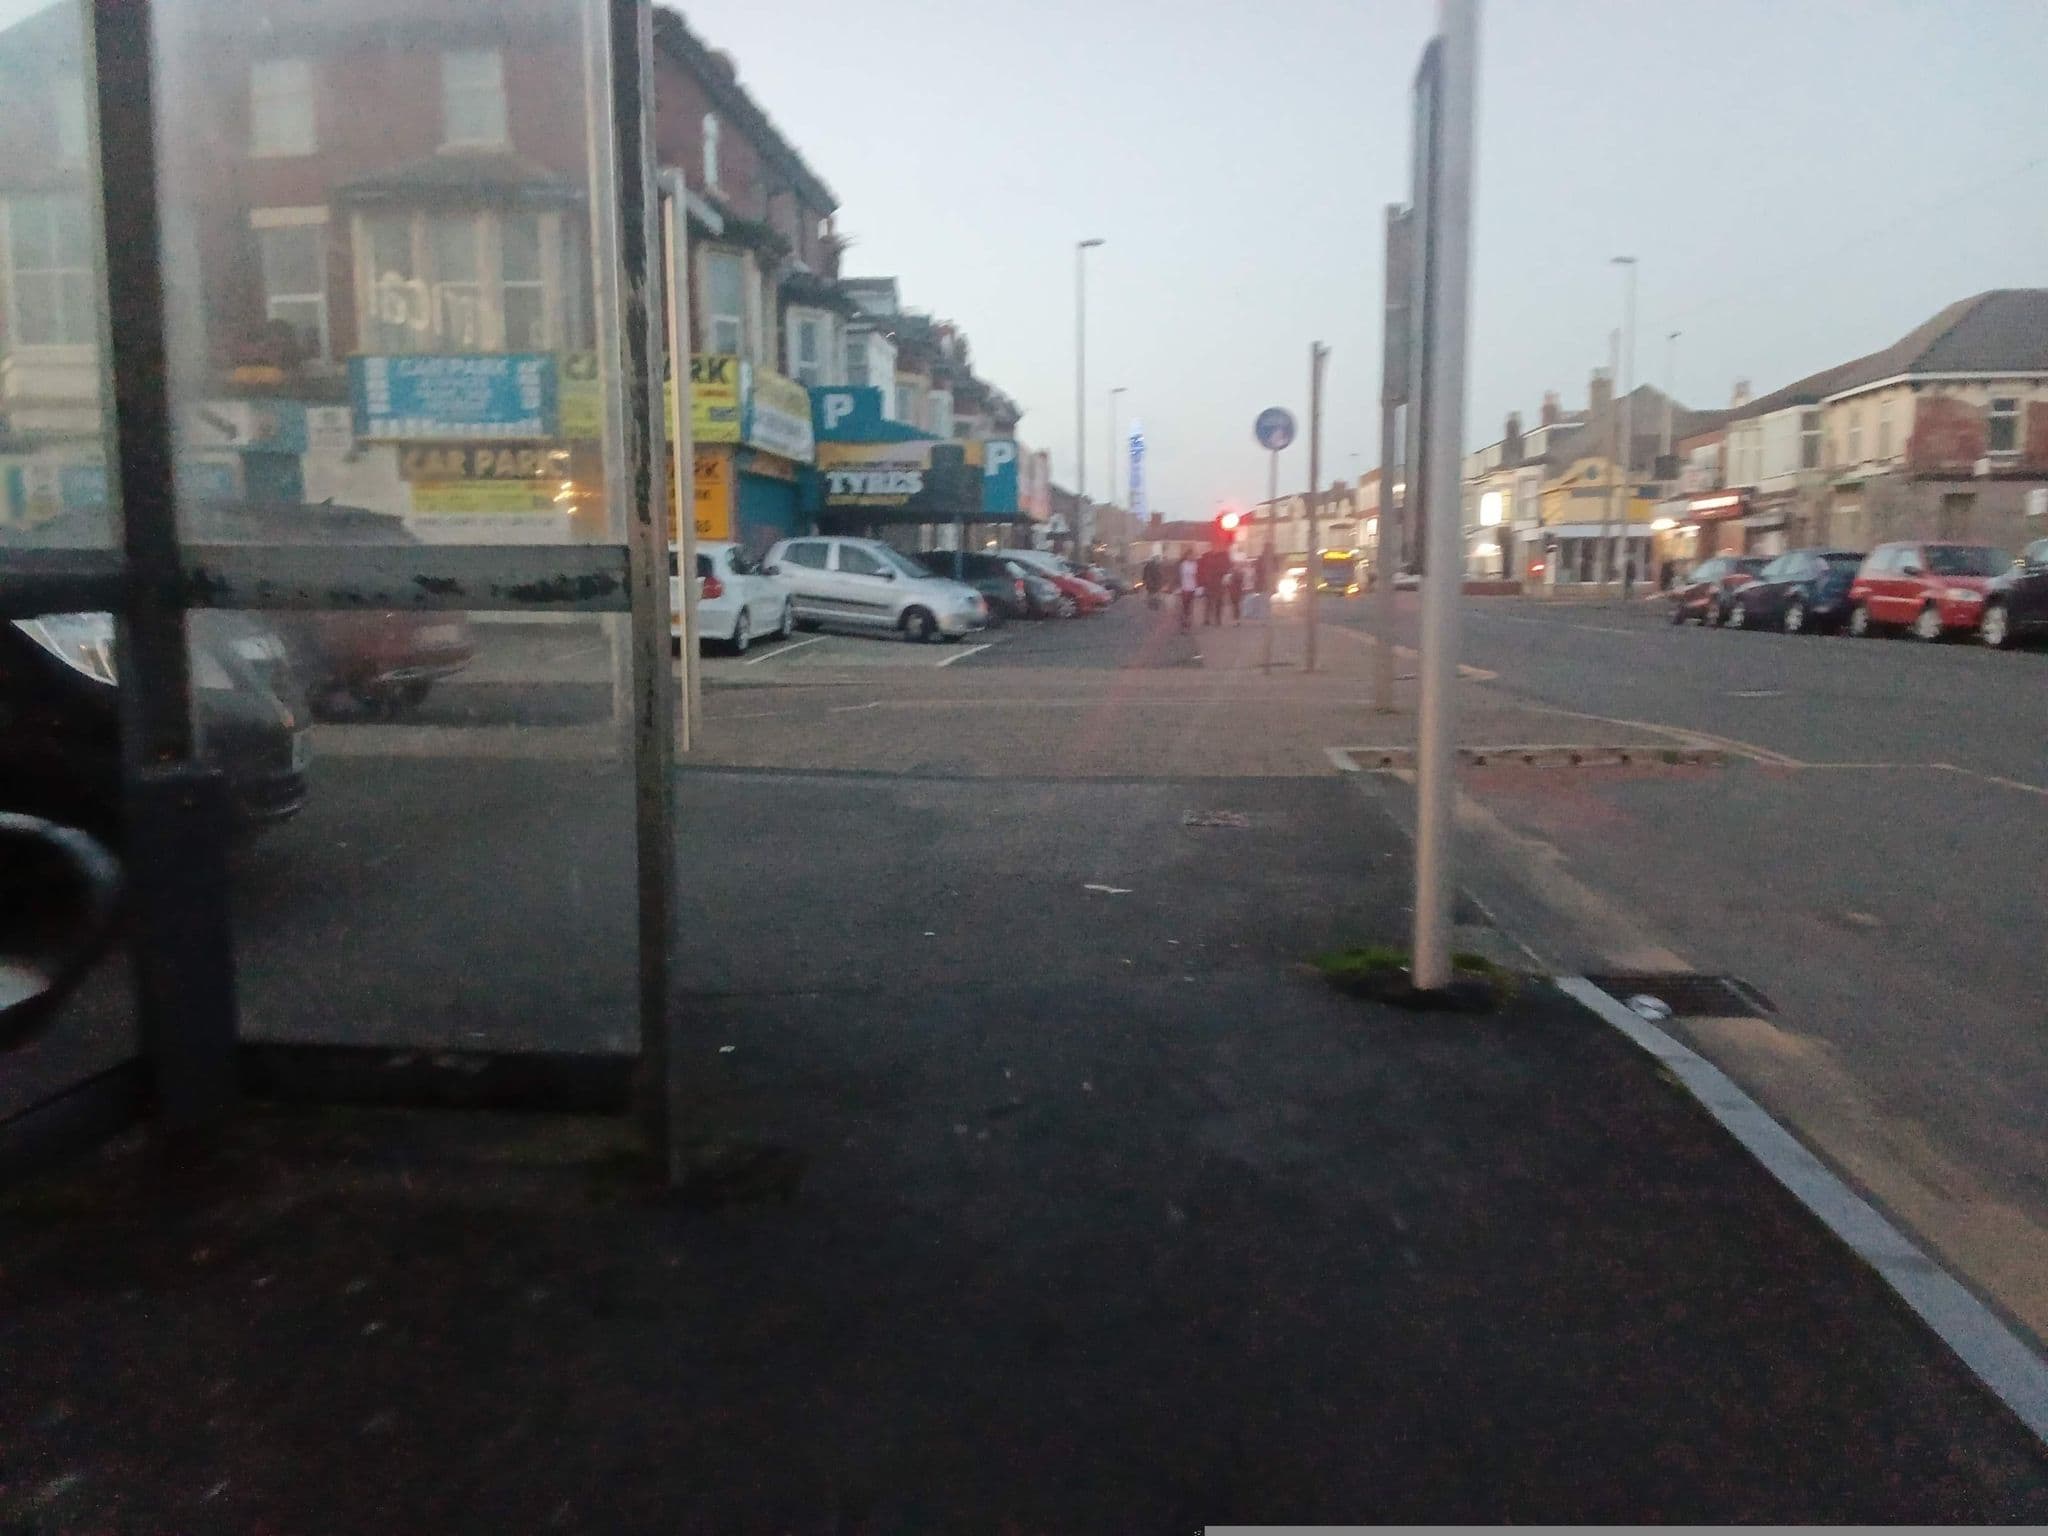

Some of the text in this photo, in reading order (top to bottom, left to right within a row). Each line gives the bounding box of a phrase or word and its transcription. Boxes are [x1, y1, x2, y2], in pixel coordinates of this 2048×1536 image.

[823, 393, 854, 430] P
[406, 449, 466, 478] CAR
[985, 441, 1015, 477] P
[825, 470, 925, 494] TYRES
